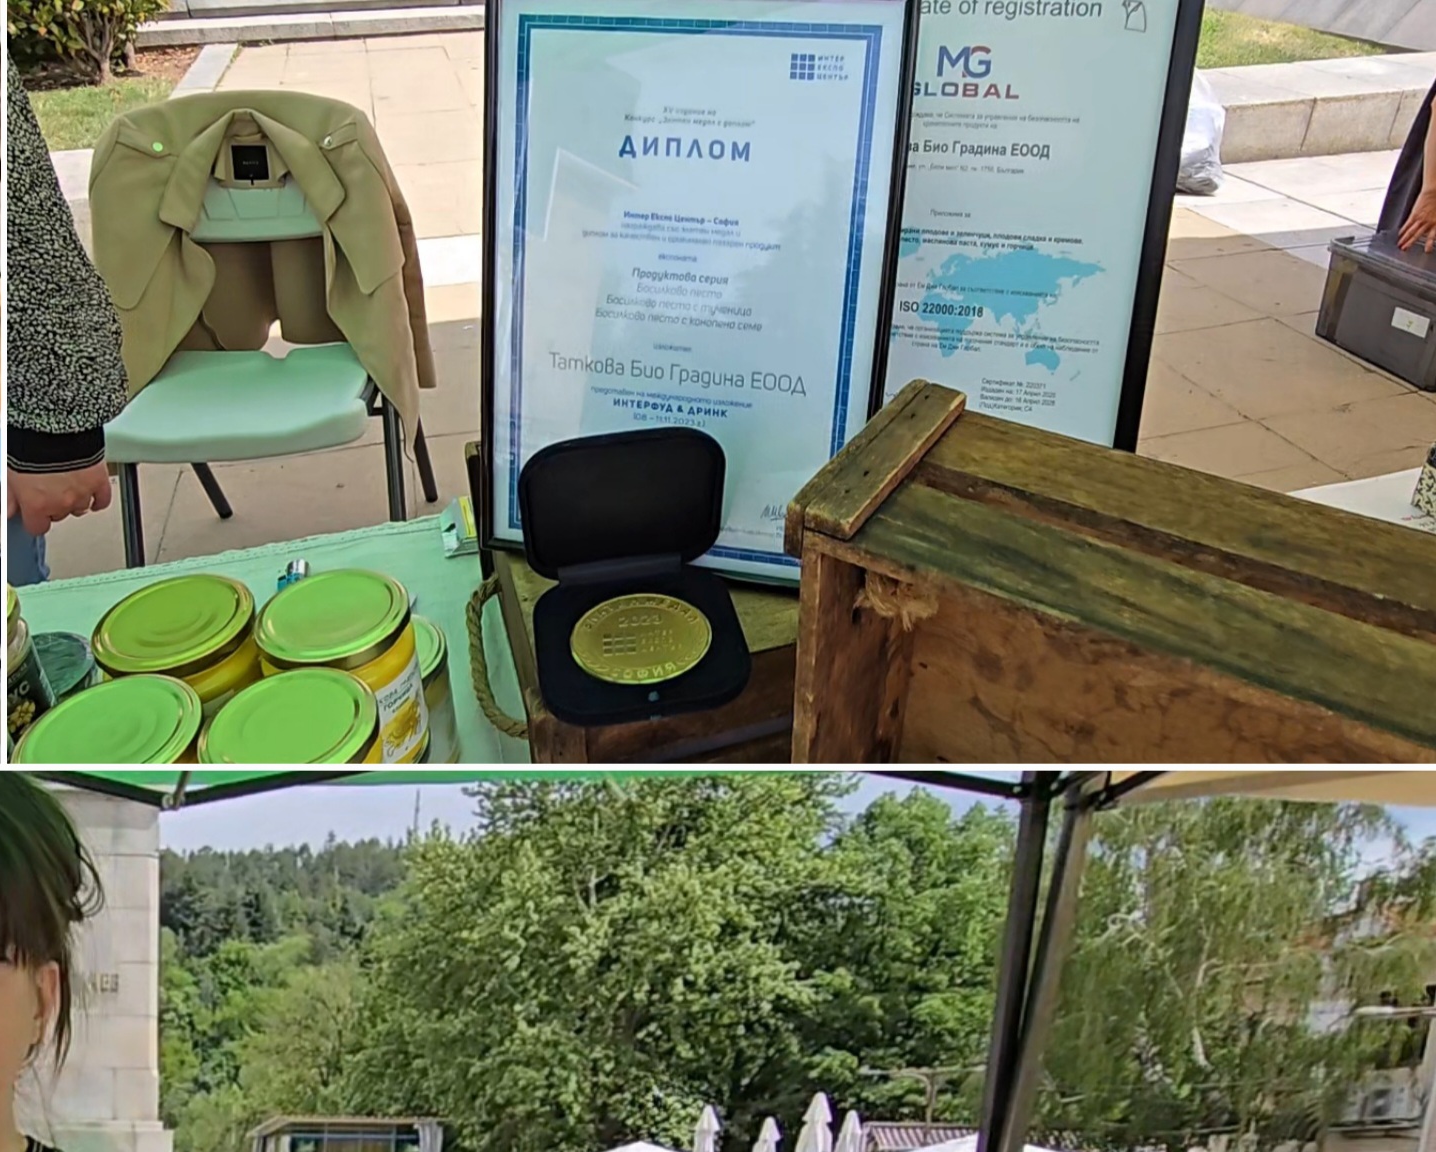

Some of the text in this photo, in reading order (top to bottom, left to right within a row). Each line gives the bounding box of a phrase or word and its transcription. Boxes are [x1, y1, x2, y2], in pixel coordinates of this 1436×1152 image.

[959, 0, 978, 14] of
[984, 0, 1102, 20] registration
[936, 46, 992, 78] MG
[619, 135, 751, 162] ДИПЛОМ
[923, 139, 948, 153] Био
[952, 141, 1006, 157] Градина
[1011, 143, 1050, 160] ЕООД
[632, 268, 729, 285] Продуктова серия
[899, 301, 984, 318] ISO 22000:2018
[549, 351, 807, 397] Таткова Био Градина ЕООД
[613, 398, 673, 414] ИНТЕРФУД
[687, 405, 728, 418] ДРИНК
